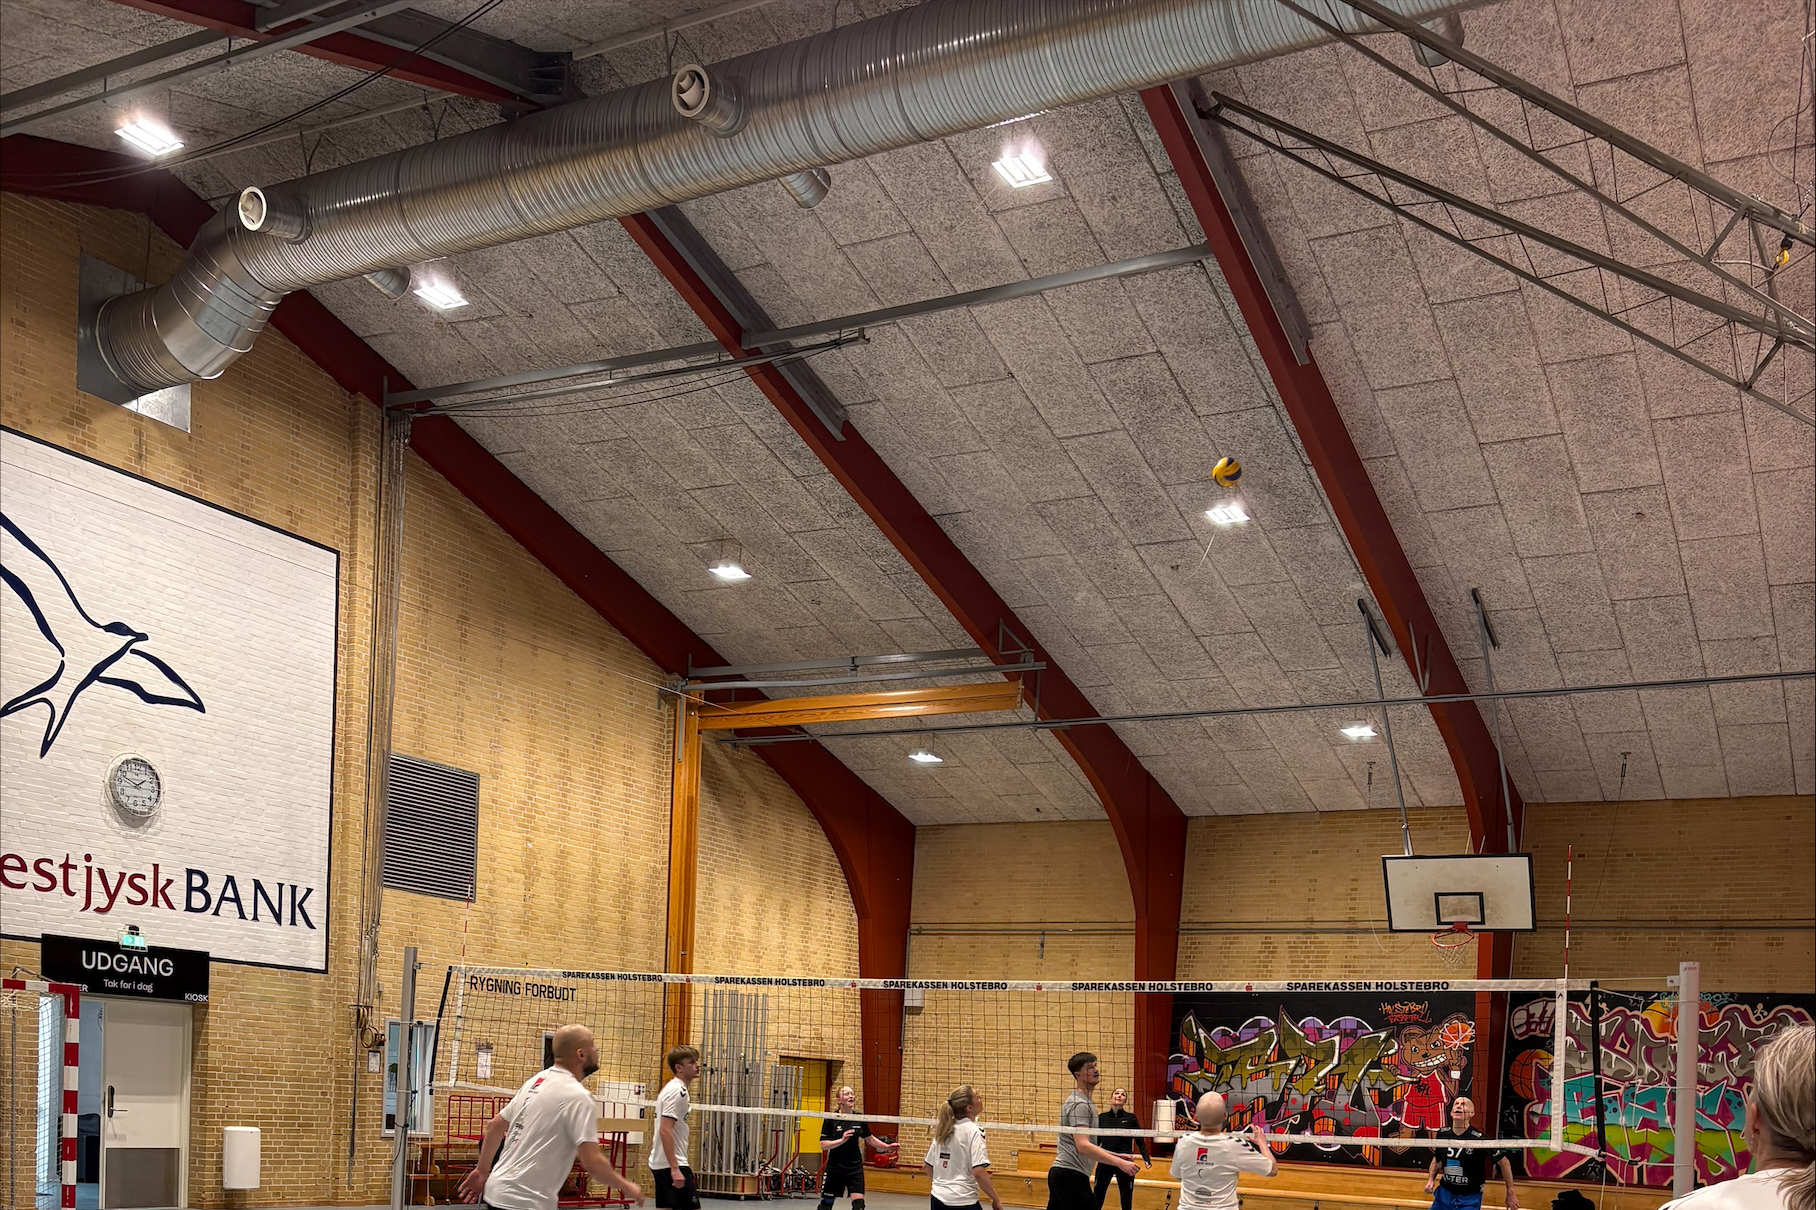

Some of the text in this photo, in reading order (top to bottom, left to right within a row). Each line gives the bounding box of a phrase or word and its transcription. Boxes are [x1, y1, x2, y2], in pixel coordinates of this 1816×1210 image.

[81, 950, 174, 977] UDGANG
[562, 971, 663, 982] SPAREKASSEN HOLSTEBRO
[714, 976, 825, 987] SPAREKASSEN HOLSTEBRO
[103, 979, 119, 988] Tak
[120, 980, 131, 990] for
[137, 981, 154, 993] dag
[470, 975, 576, 1002] RYGNING FORBUDT
[883, 980, 1008, 990] SPAREKASSEN HOLSTEBRO
[1071, 982, 1213, 991] SPAREKASSEN HOLSTEBRO
[1286, 980, 1450, 991] SPAREKASSEN HOLSTEBRO
[184, 992, 209, 1002] KIOSK
